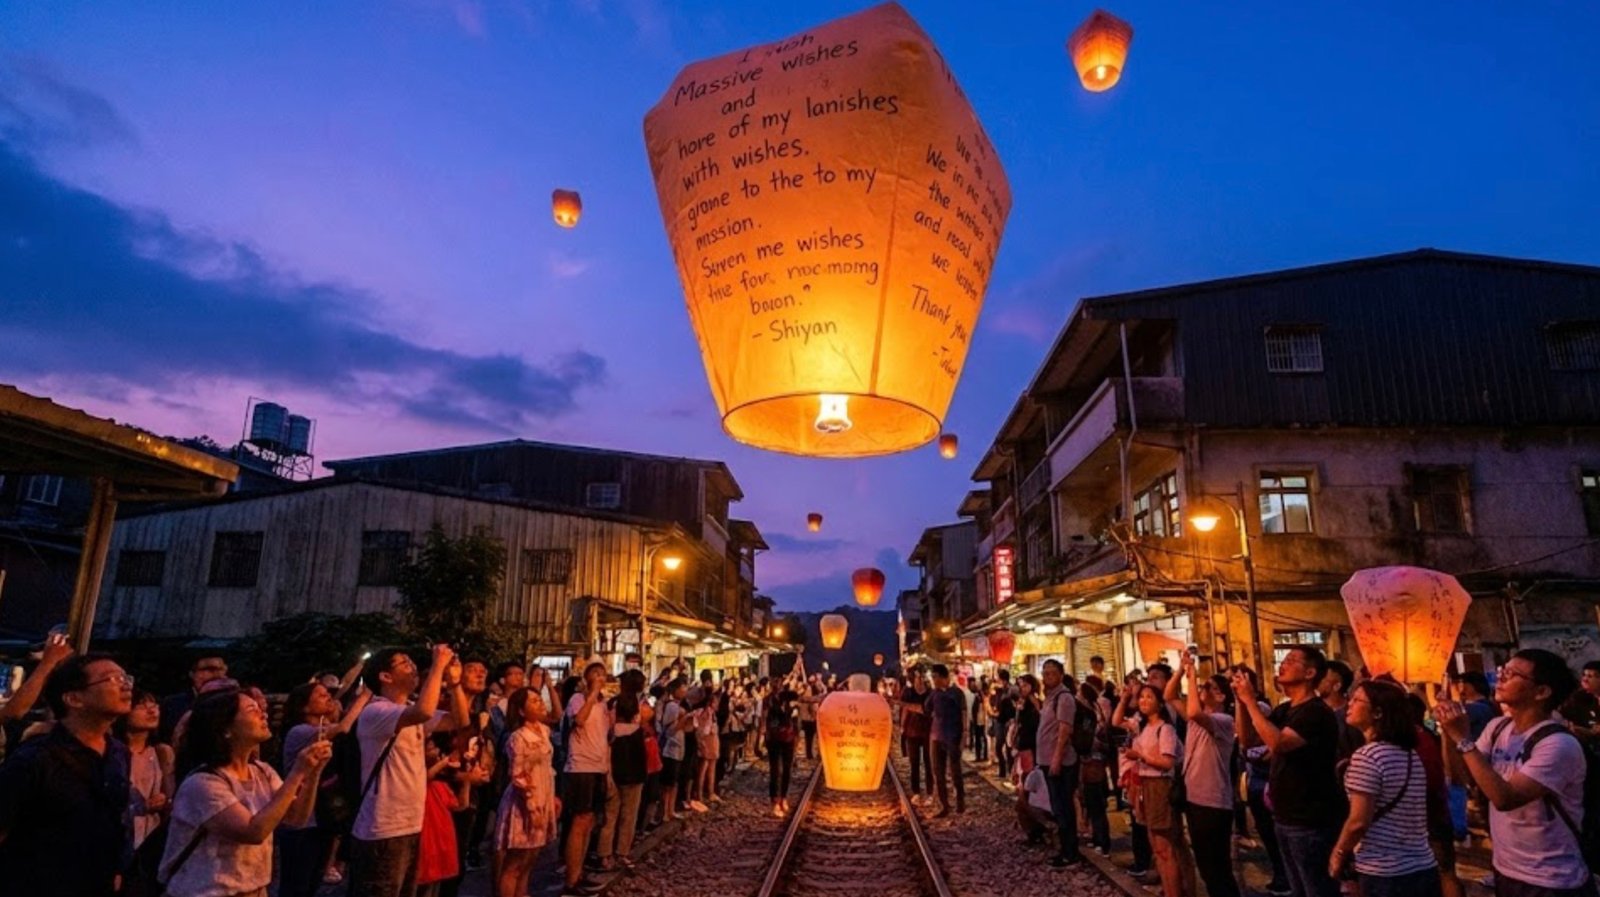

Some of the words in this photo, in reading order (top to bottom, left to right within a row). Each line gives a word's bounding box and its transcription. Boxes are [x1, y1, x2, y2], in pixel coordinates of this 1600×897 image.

[674, 68, 764, 107] Massive
[781, 40, 859, 71] wishes
[721, 88, 756, 116] and
[728, 115, 751, 139] of
[762, 110, 792, 135] my
[926, 143, 947, 173] We
[682, 157, 720, 191] with
[740, 178, 760, 199] to
[769, 171, 804, 192] the
[814, 163, 836, 184] to
[846, 165, 877, 194] my
[929, 179, 951, 209] the
[914, 210, 943, 234] and
[757, 241, 784, 260] me
[797, 226, 865, 253] wishes
[912, 284, 952, 326] Thank
[769, 318, 838, 345] Shiyan
